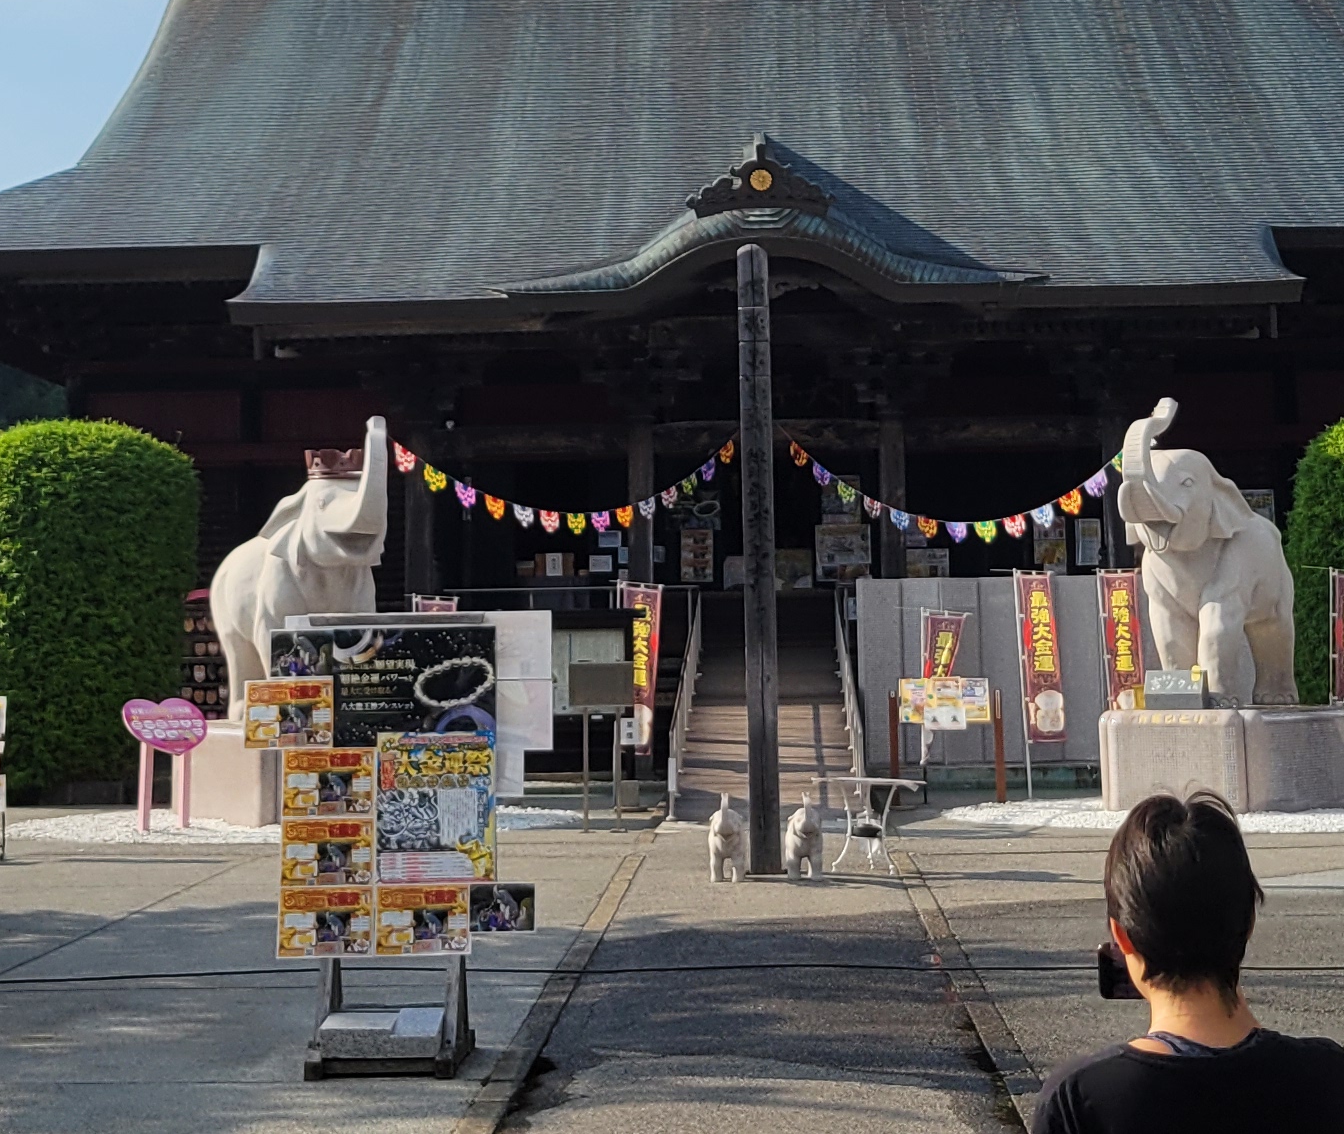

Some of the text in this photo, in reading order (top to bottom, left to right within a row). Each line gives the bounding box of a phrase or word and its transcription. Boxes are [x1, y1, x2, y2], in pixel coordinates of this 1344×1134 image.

[1030, 591, 1055, 672] 最強大金運
[1111, 590, 1135, 672] 最強大金運
[394, 748, 493, 777] 大金運祭
